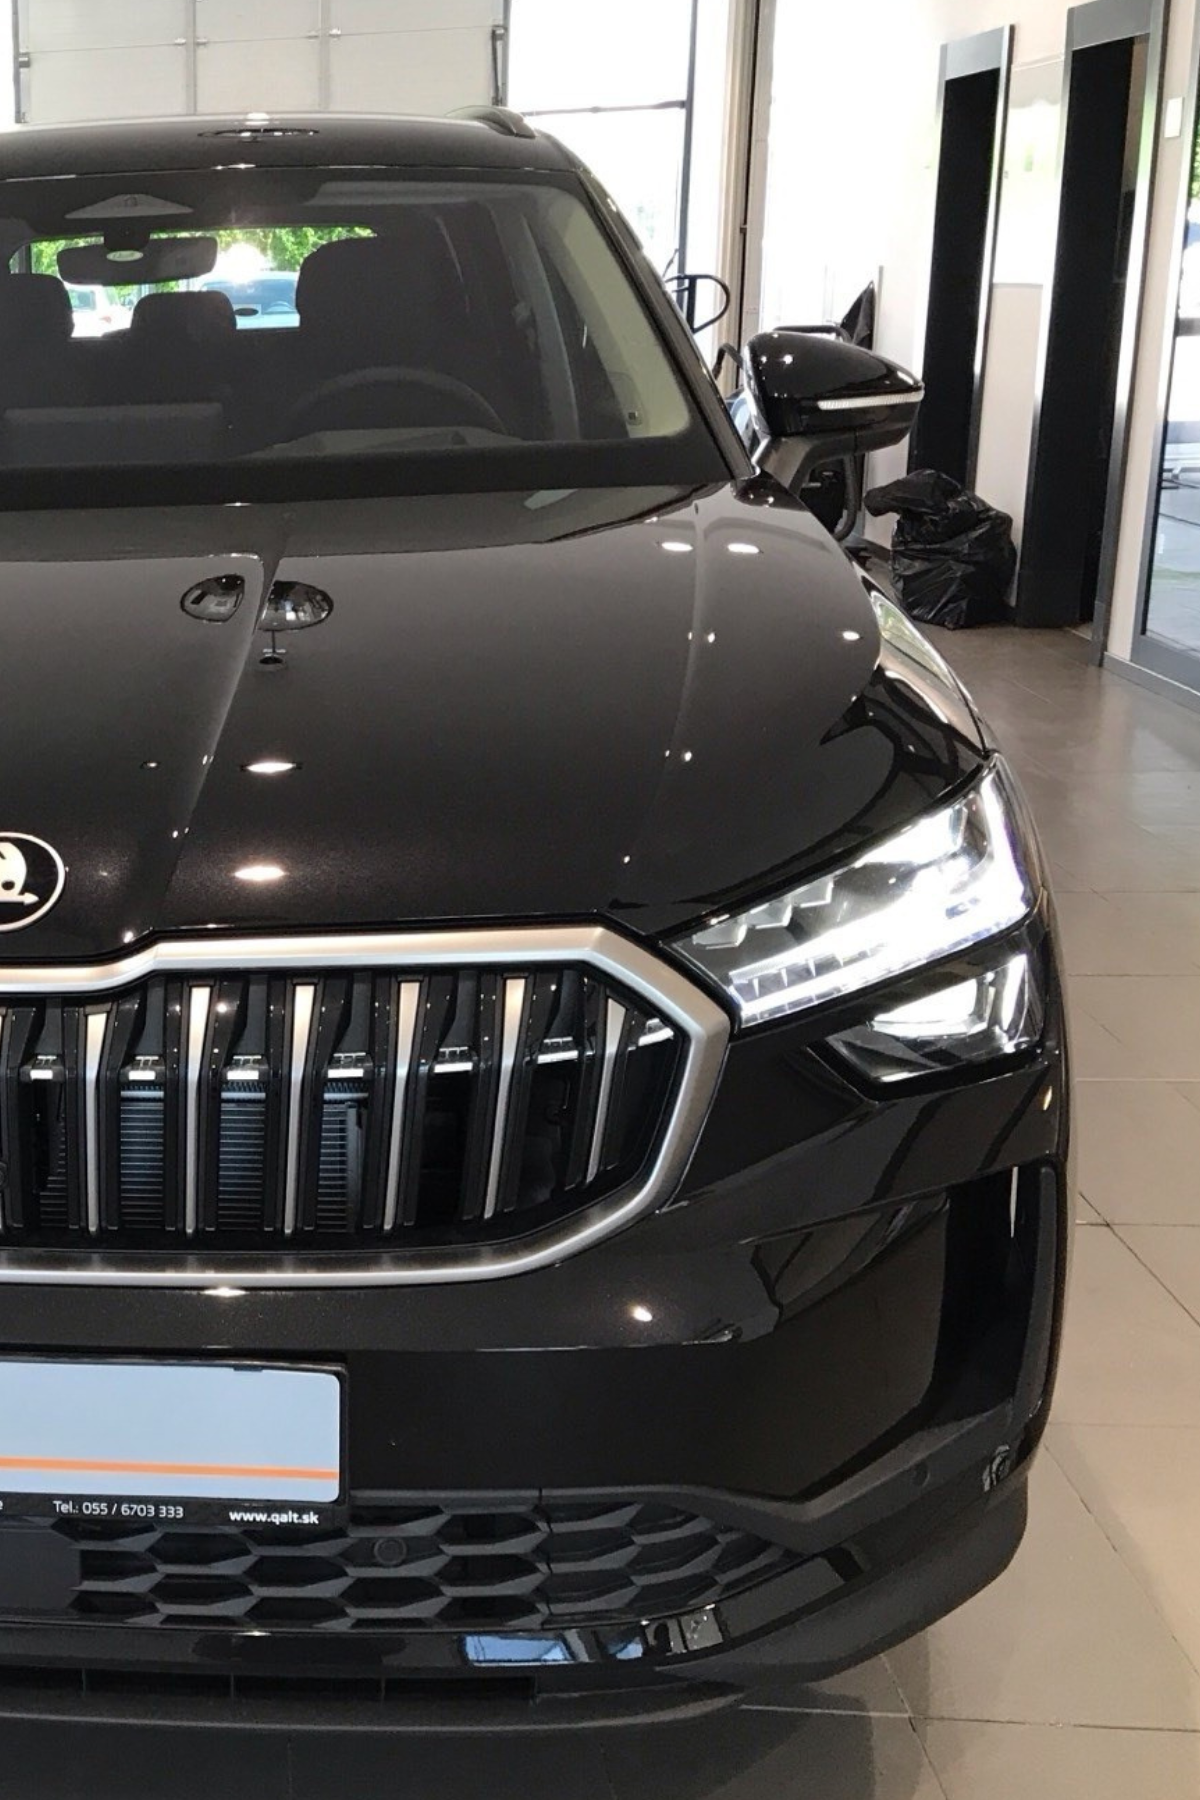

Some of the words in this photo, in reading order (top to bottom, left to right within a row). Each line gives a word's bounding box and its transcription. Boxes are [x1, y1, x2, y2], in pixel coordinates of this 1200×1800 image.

[53, 1500, 79, 1514] Tel.:
[82, 1501, 108, 1515] 055
[111, 1503, 118, 1515] /
[120, 1504, 155, 1517] 6703
[158, 1505, 184, 1519] 333
[228, 1510, 319, 1525] www.qalt.sk
